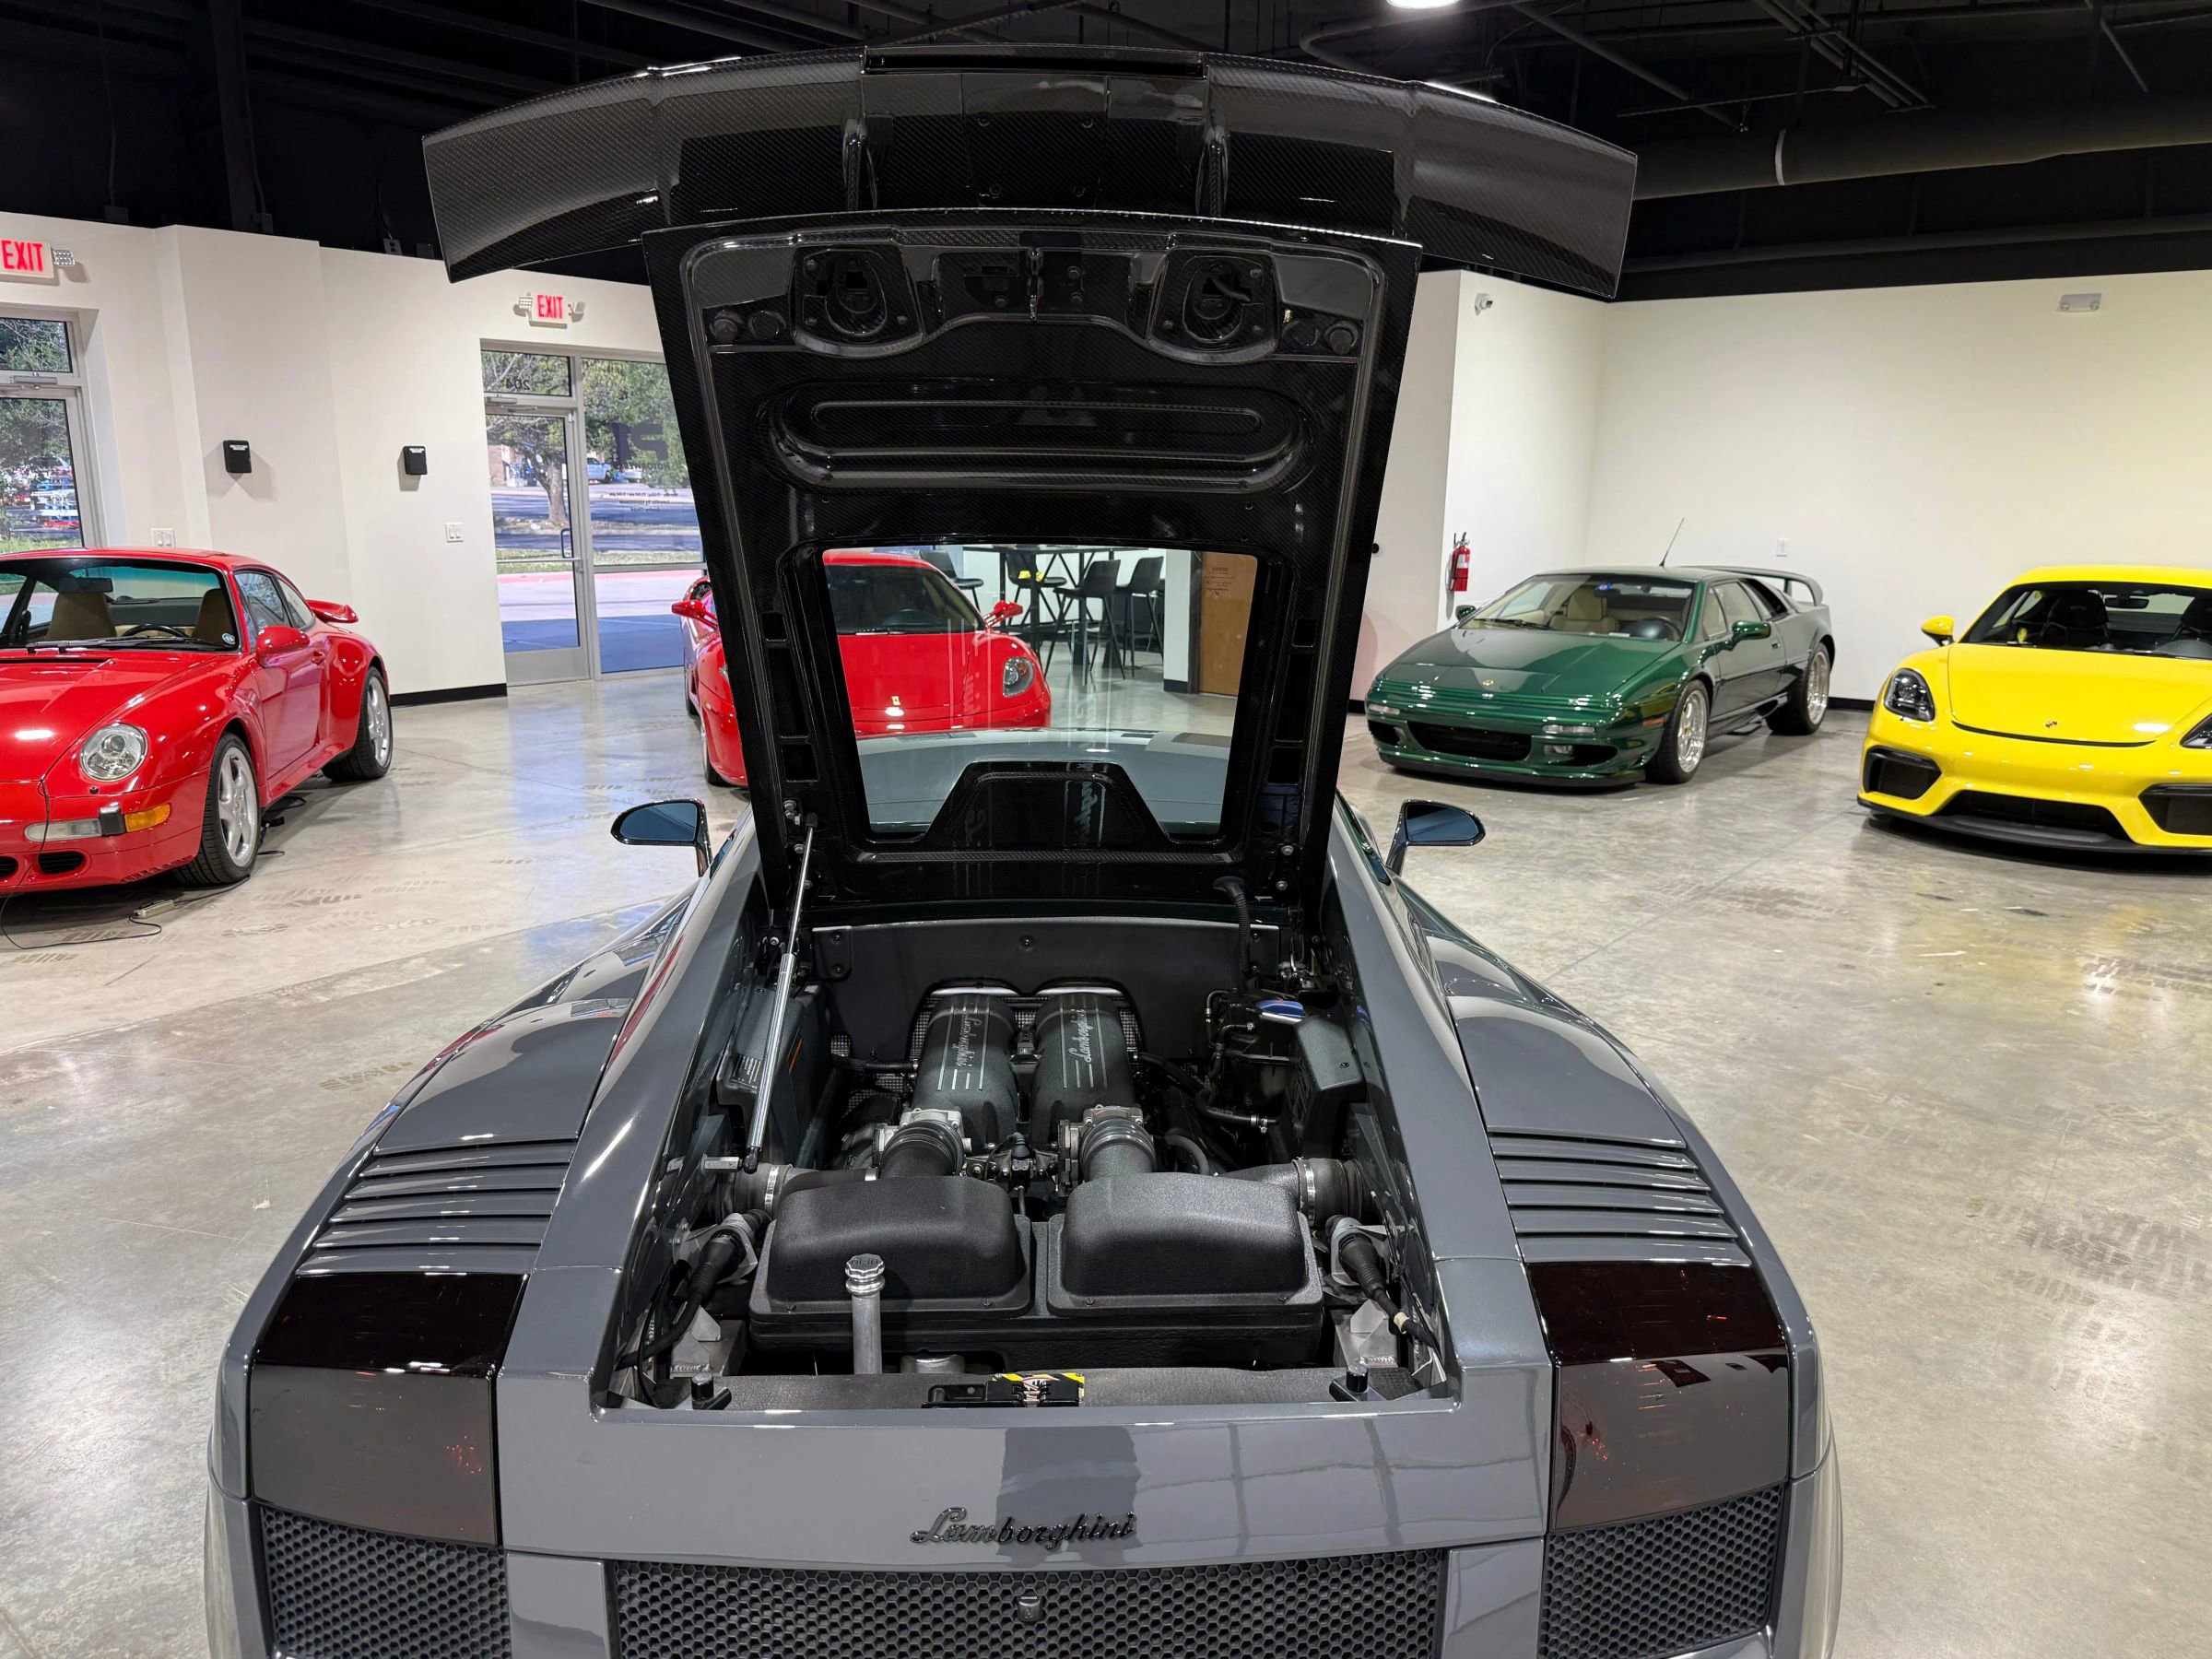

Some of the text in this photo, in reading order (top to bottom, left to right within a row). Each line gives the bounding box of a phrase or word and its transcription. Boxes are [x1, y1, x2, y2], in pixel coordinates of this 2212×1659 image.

[1, 240, 43, 272] EXIT
[536, 294, 563, 319] EXIT
[910, 1506, 1135, 1551] Lamborghini
